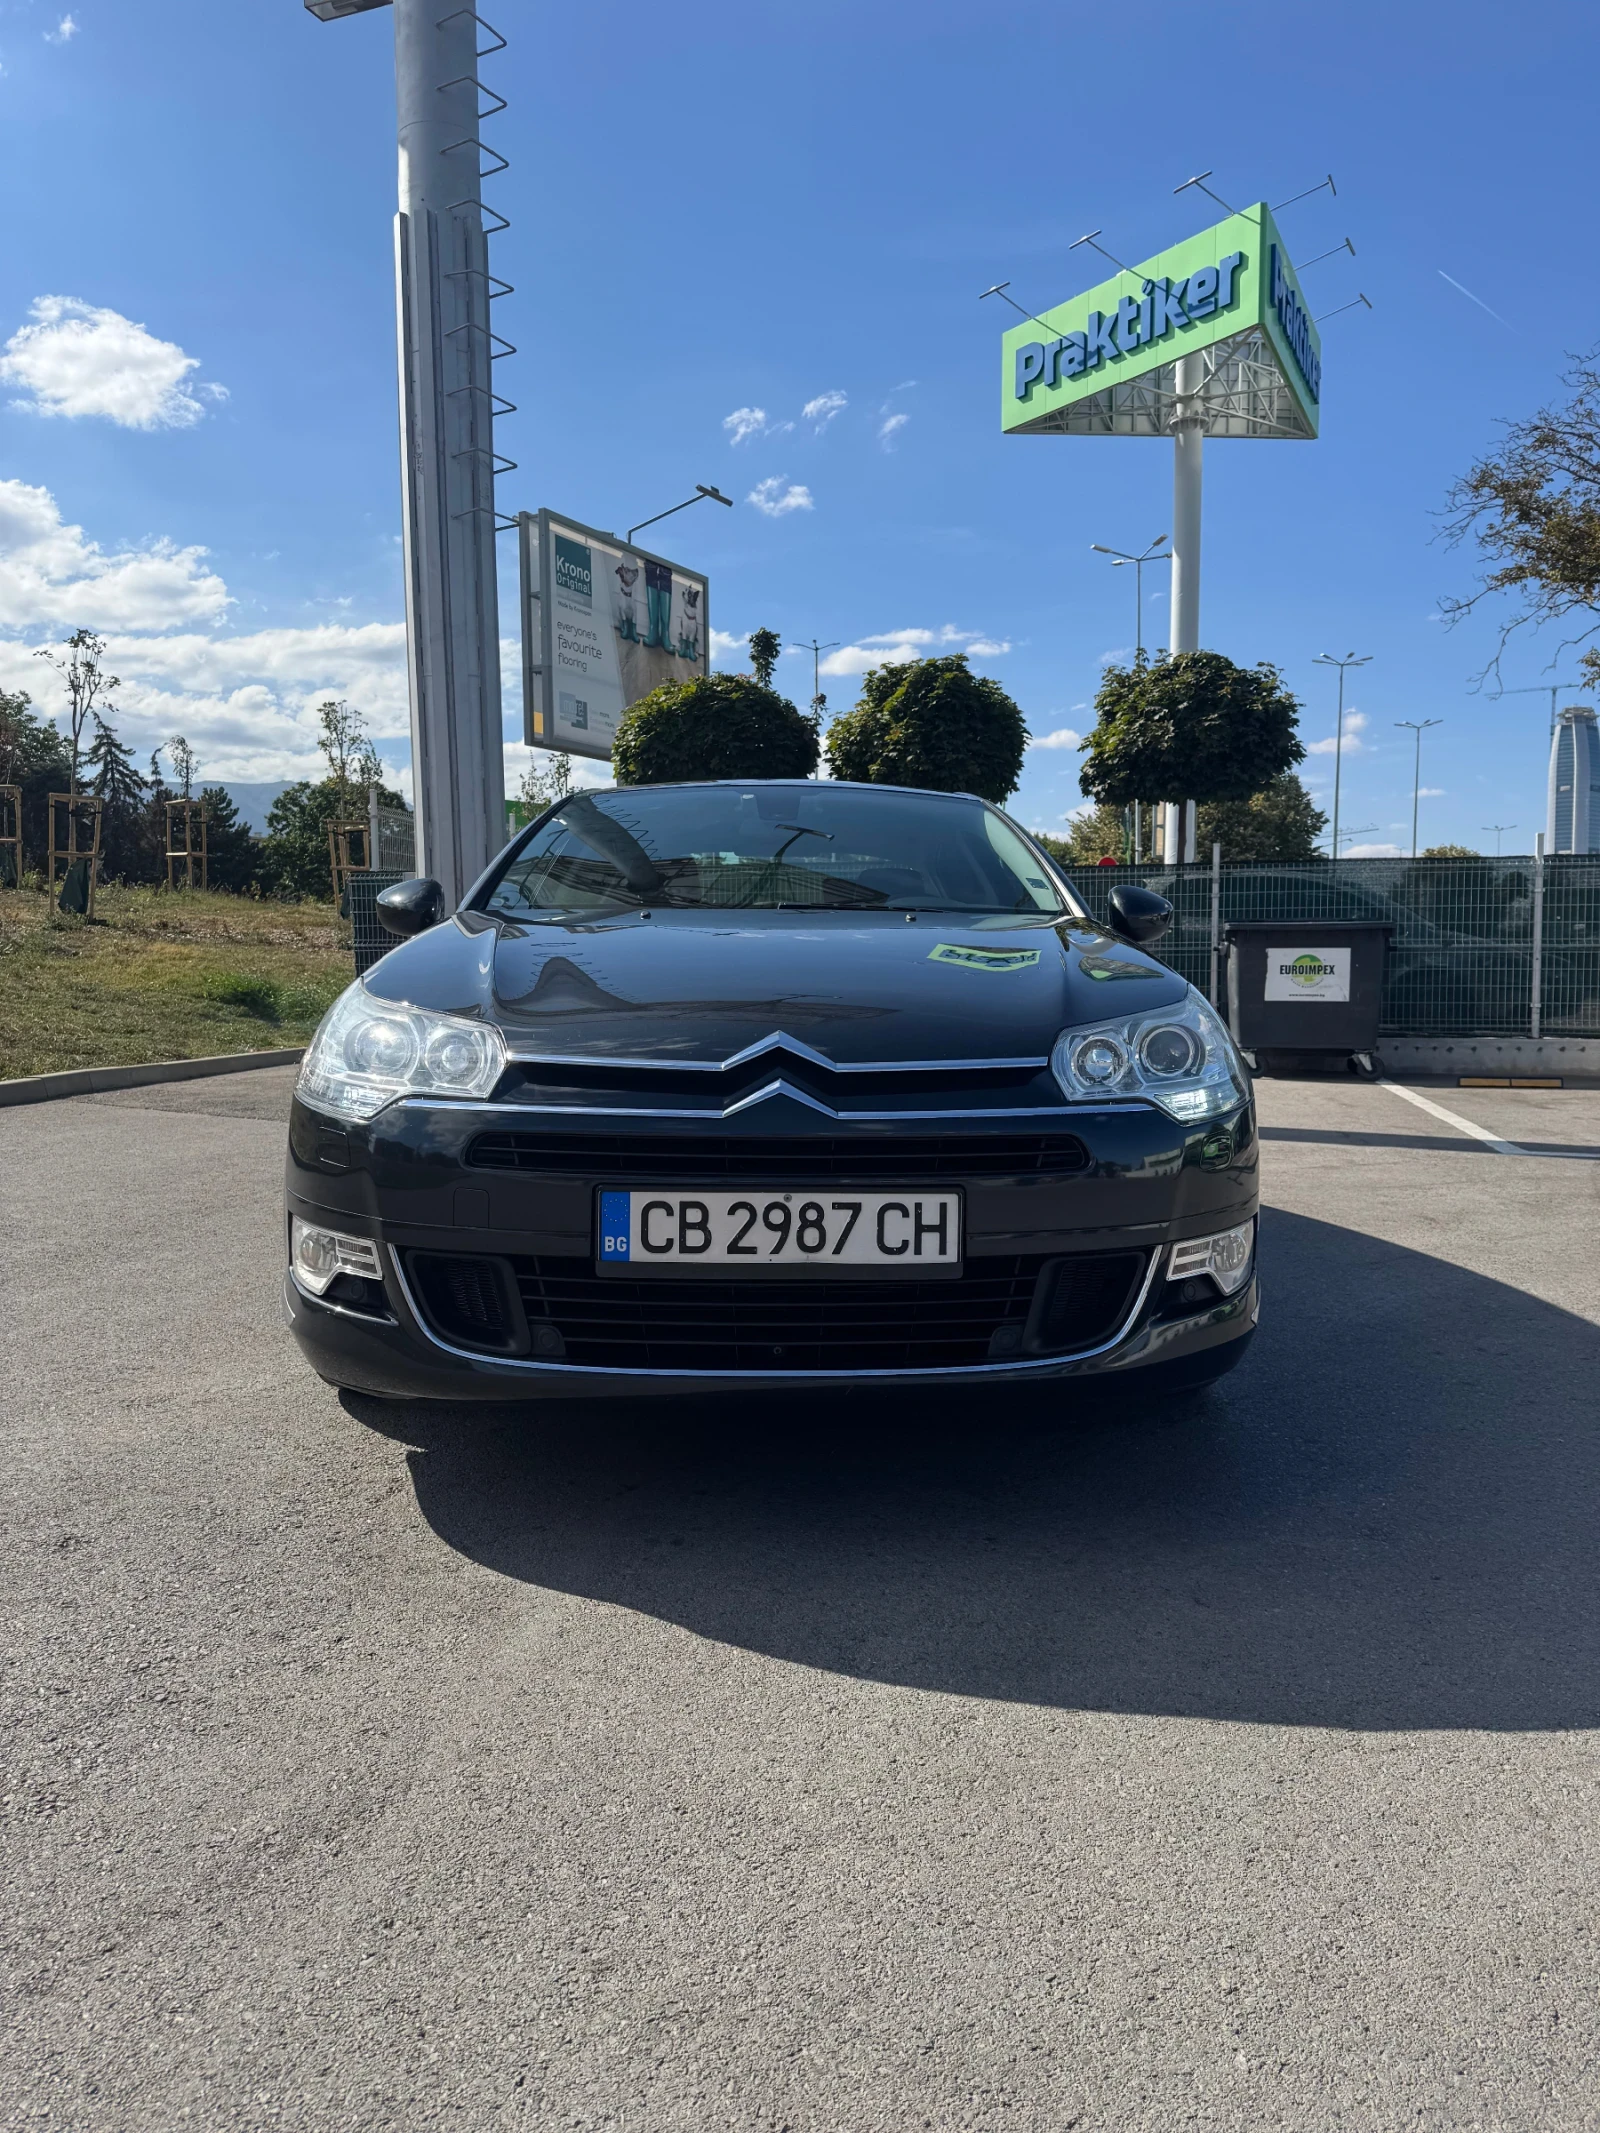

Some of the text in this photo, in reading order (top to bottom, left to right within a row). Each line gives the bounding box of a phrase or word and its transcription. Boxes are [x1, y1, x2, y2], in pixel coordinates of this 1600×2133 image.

[1015, 251, 1246, 401] Praktiker
[556, 555, 591, 582] Krono
[556, 572, 591, 595] Original
[556, 621, 598, 641] everyone's
[557, 633, 603, 660] favourite
[557, 652, 588, 673] flooring
[1279, 964, 1335, 975] EUROIMPEX
[640, 1200, 948, 1256] CB 2987 CH
[604, 1237, 627, 1253] BG
